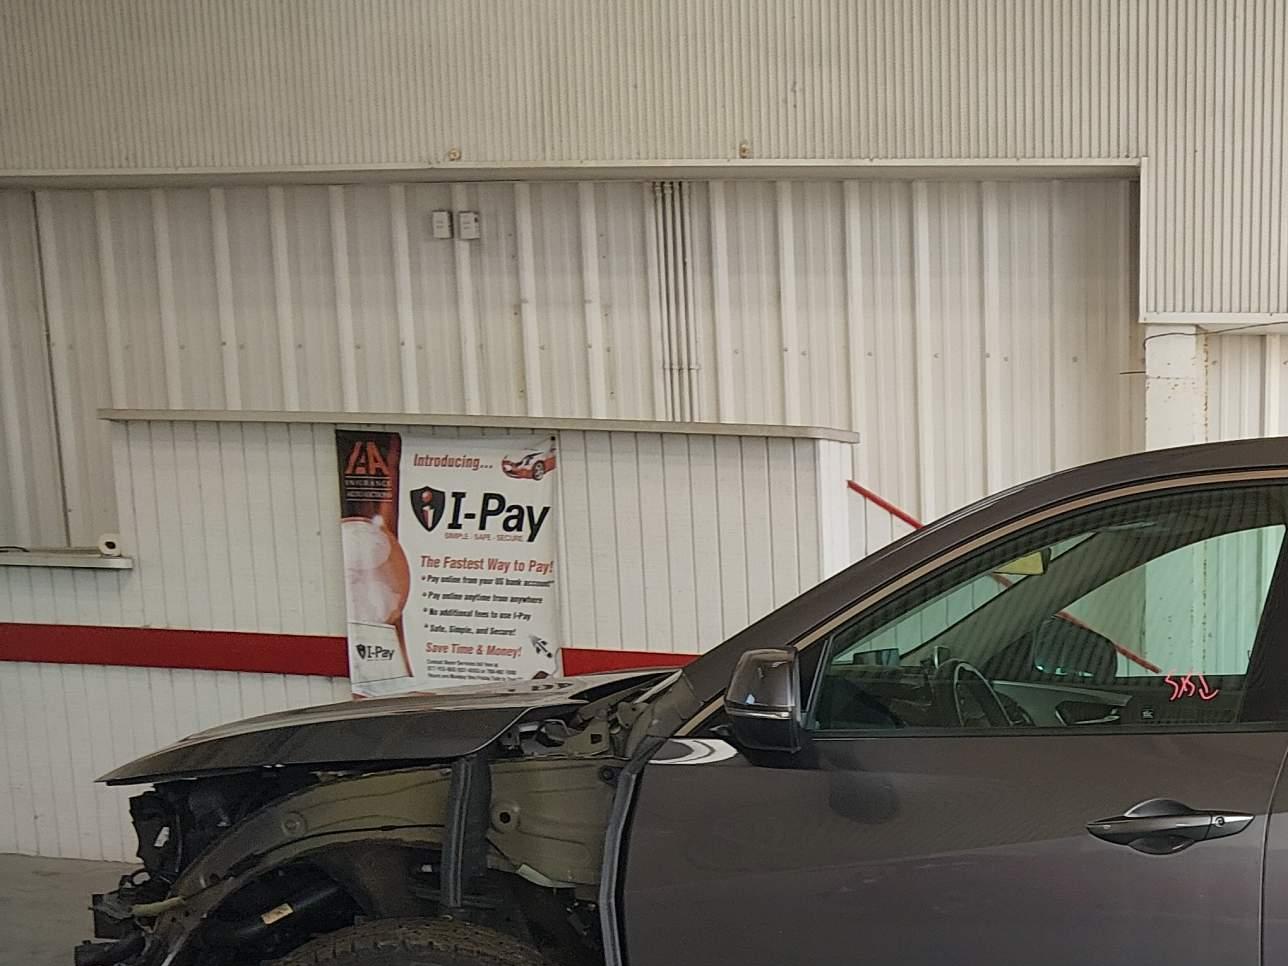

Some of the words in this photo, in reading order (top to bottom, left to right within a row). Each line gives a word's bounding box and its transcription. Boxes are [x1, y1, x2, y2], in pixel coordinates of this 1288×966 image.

[413, 453, 493, 471] Introducing...
[447, 491, 551, 543] I-Pay
[421, 555, 440, 568] The
[443, 556, 484, 570] Fastest
[487, 558, 511, 574] Way
[514, 560, 526, 572] to
[528, 560, 554, 575] Pay!
[427, 574, 440, 584] Pay
[428, 591, 441, 601] Pay
[367, 645, 395, 661] I-Pay
[425, 642, 449, 654] Save
[451, 643, 474, 655] Time
[476, 644, 483, 655] &
[486, 645, 522, 659] Money!
